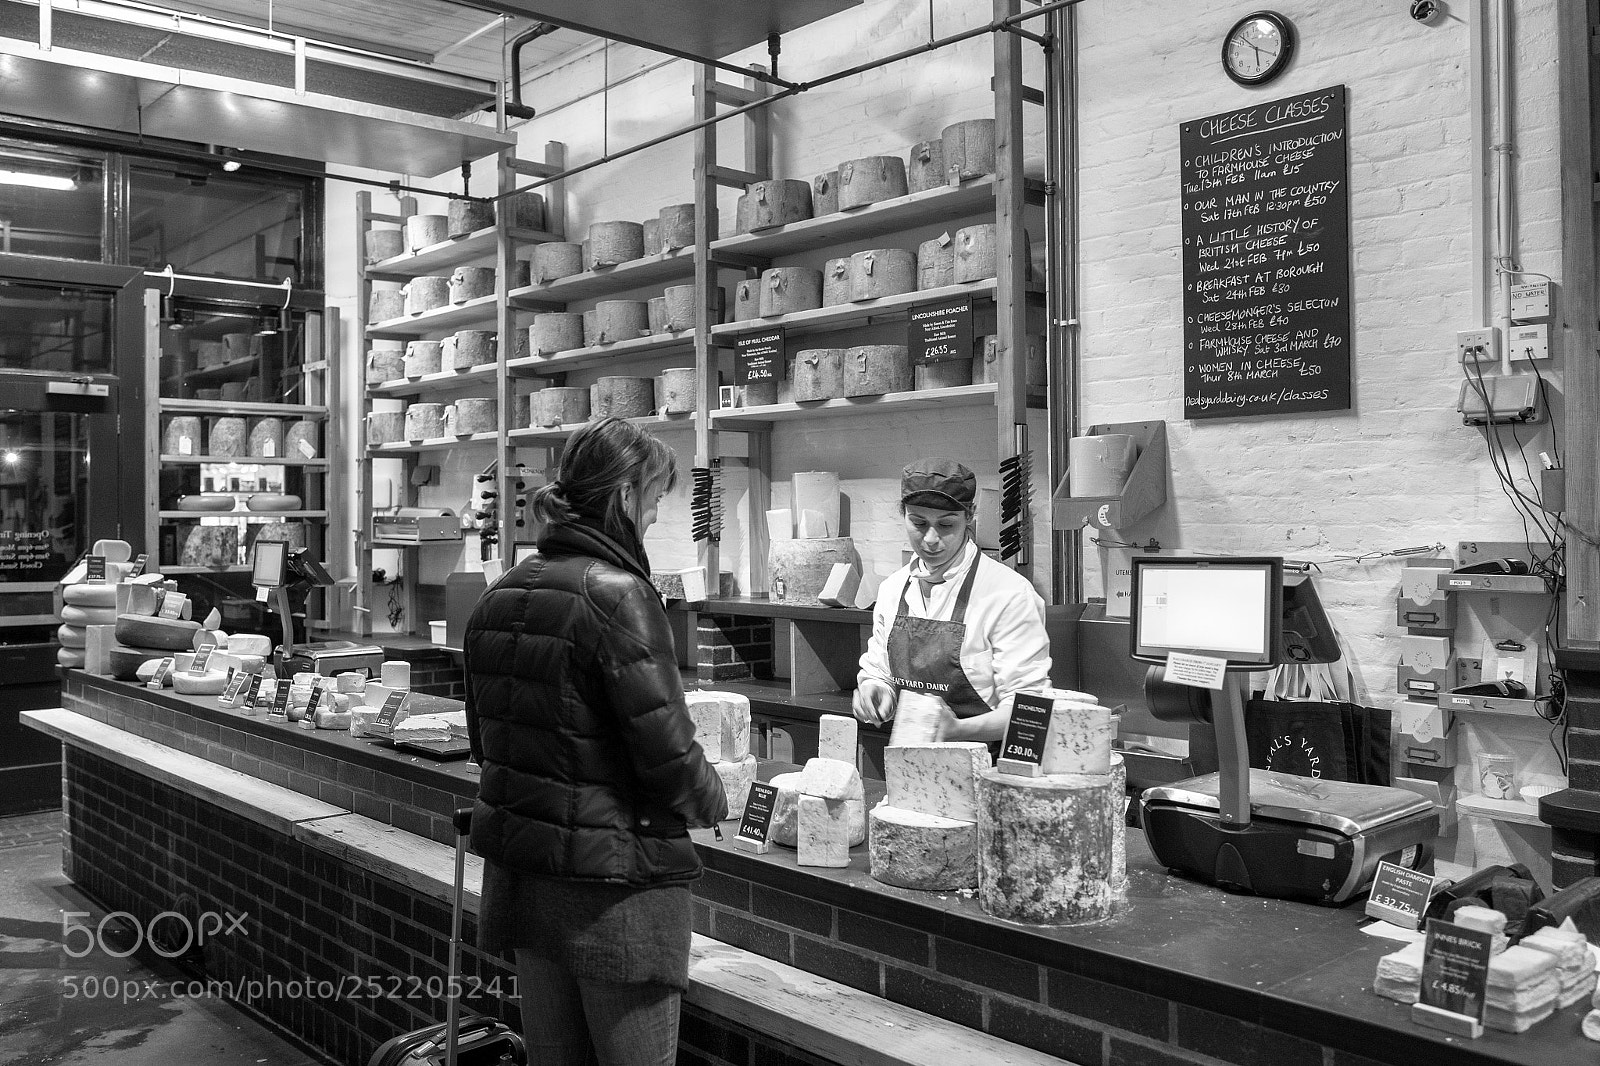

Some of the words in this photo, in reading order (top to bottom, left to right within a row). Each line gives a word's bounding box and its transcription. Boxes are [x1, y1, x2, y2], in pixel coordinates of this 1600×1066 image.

[1200, 110, 1257, 139] CHEESE
[1265, 95, 1330, 124] CLASSES
[1195, 143, 1261, 168] CHILDREN'S
[1269, 129, 1343, 154] INTRODUCTION
[1196, 170, 1209, 179] TO
[1212, 157, 1270, 178] FARMHOUSE
[1275, 147, 1315, 165] CHEESE
[1225, 173, 1245, 185] FEB
[1254, 170, 1277, 180] 11am
[1283, 163, 1304, 175] £15
[1194, 200, 1217, 211] OUR
[1225, 192, 1250, 207] MAN
[1254, 190, 1264, 201] IN
[1269, 187, 1287, 199] THE
[1290, 180, 1340, 197] COUNTRY
[1200, 211, 1220, 223] Sat
[1224, 208, 1242, 220] 17th
[1244, 204, 1260, 215] FEB
[1304, 195, 1327, 208] £50
[1196, 235, 1204, 247] A
[1209, 225, 1252, 244] LITTLE
[1256, 217, 1300, 236] HISTORY
[1302, 218, 1318, 228] OF
[1198, 244, 1239, 259] BRITISH
[1245, 235, 1288, 251] CHEESE
[1199, 262, 1219, 273] Wed
[1224, 258, 1245, 269] 21st
[1247, 253, 1267, 265] FEB
[1273, 248, 1293, 261] 7pm
[1297, 241, 1320, 256] £50
[1196, 274, 1250, 292] BREAKFAST
[1255, 272, 1272, 283] AT
[1276, 262, 1324, 279] BOROUGH
[1202, 292, 1220, 303] Sat
[1225, 288, 1248, 300] 24th
[1248, 286, 1266, 297] FEB
[912, 310, 945, 320] LINCOLNSHIRE
[946, 306, 968, 314] POACHER
[1197, 303, 1281, 324] CHEESEMONGER'S
[1200, 324, 1220, 334] Wed
[1225, 321, 1247, 331] 28th
[1248, 319, 1265, 329] FEB
[1269, 316, 1289, 326] £40
[1199, 335, 1252, 351] FARMHOUSE
[1255, 332, 1291, 344] CHEESE
[1295, 328, 1319, 340] AND
[1254, 345, 1270, 355] Sat
[1274, 342, 1288, 353] 3rd
[1290, 339, 1318, 350] MARCH
[1323, 333, 1342, 348] £70
[1198, 361, 1233, 374] WOMEN
[1241, 361, 1251, 370] IN
[1256, 357, 1302, 369] CHEESE
[1201, 373, 1222, 383] Thur
[1227, 371, 1242, 382] 8th
[1246, 370, 1278, 380] MARCH
[1299, 362, 1322, 376] £50
[1470, 543, 1478, 553] 3
[1482, 577, 1492, 588] 3
[1473, 662, 1481, 670] 2
[905, 680, 924, 689] YARD
[926, 683, 949, 691] DAIRY
[1017, 703, 1046, 714] STICHELTON
[1483, 700, 1495, 709] 2
[1300, 737, 1321, 779] YARD
[1382, 865, 1405, 877] ENGLISH
[1406, 872, 1431, 885] DAMSON
[1396, 878, 1413, 887] PASTE
[1434, 933, 1457, 944] INNES
[1458, 937, 1482, 950] BRICK
